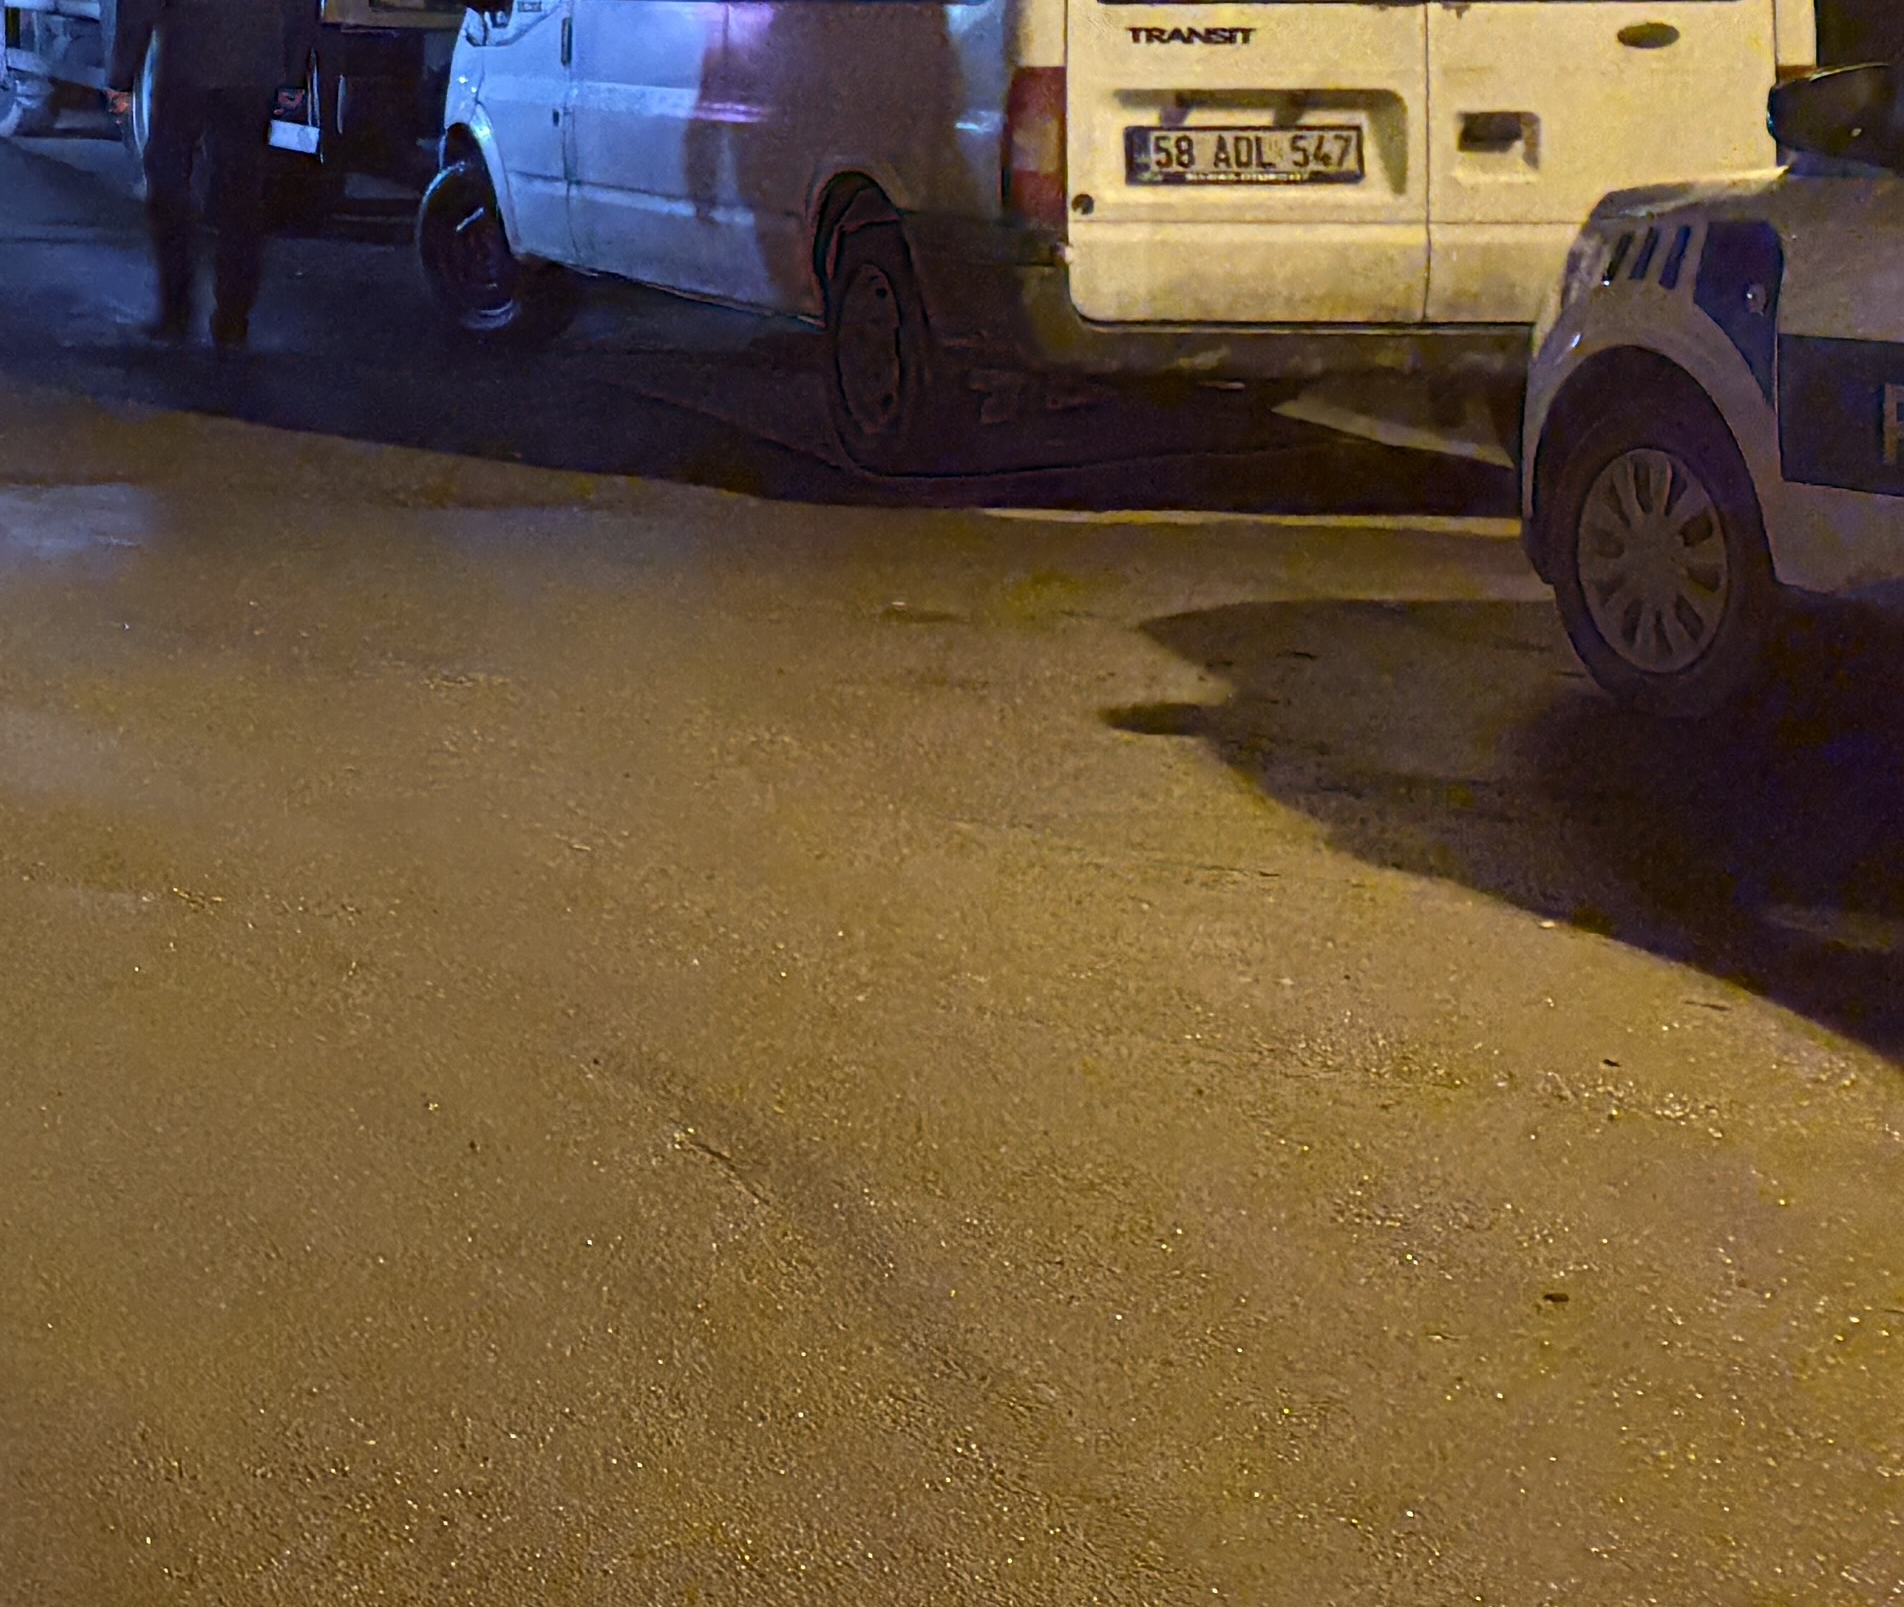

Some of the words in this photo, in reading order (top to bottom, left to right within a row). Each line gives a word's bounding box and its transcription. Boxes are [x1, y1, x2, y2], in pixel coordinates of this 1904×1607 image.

[1125, 26, 1256, 45] TRANSIT
[1153, 134, 1196, 170] 58
[1212, 134, 1276, 170] ADL
[1289, 134, 1353, 168] 547
